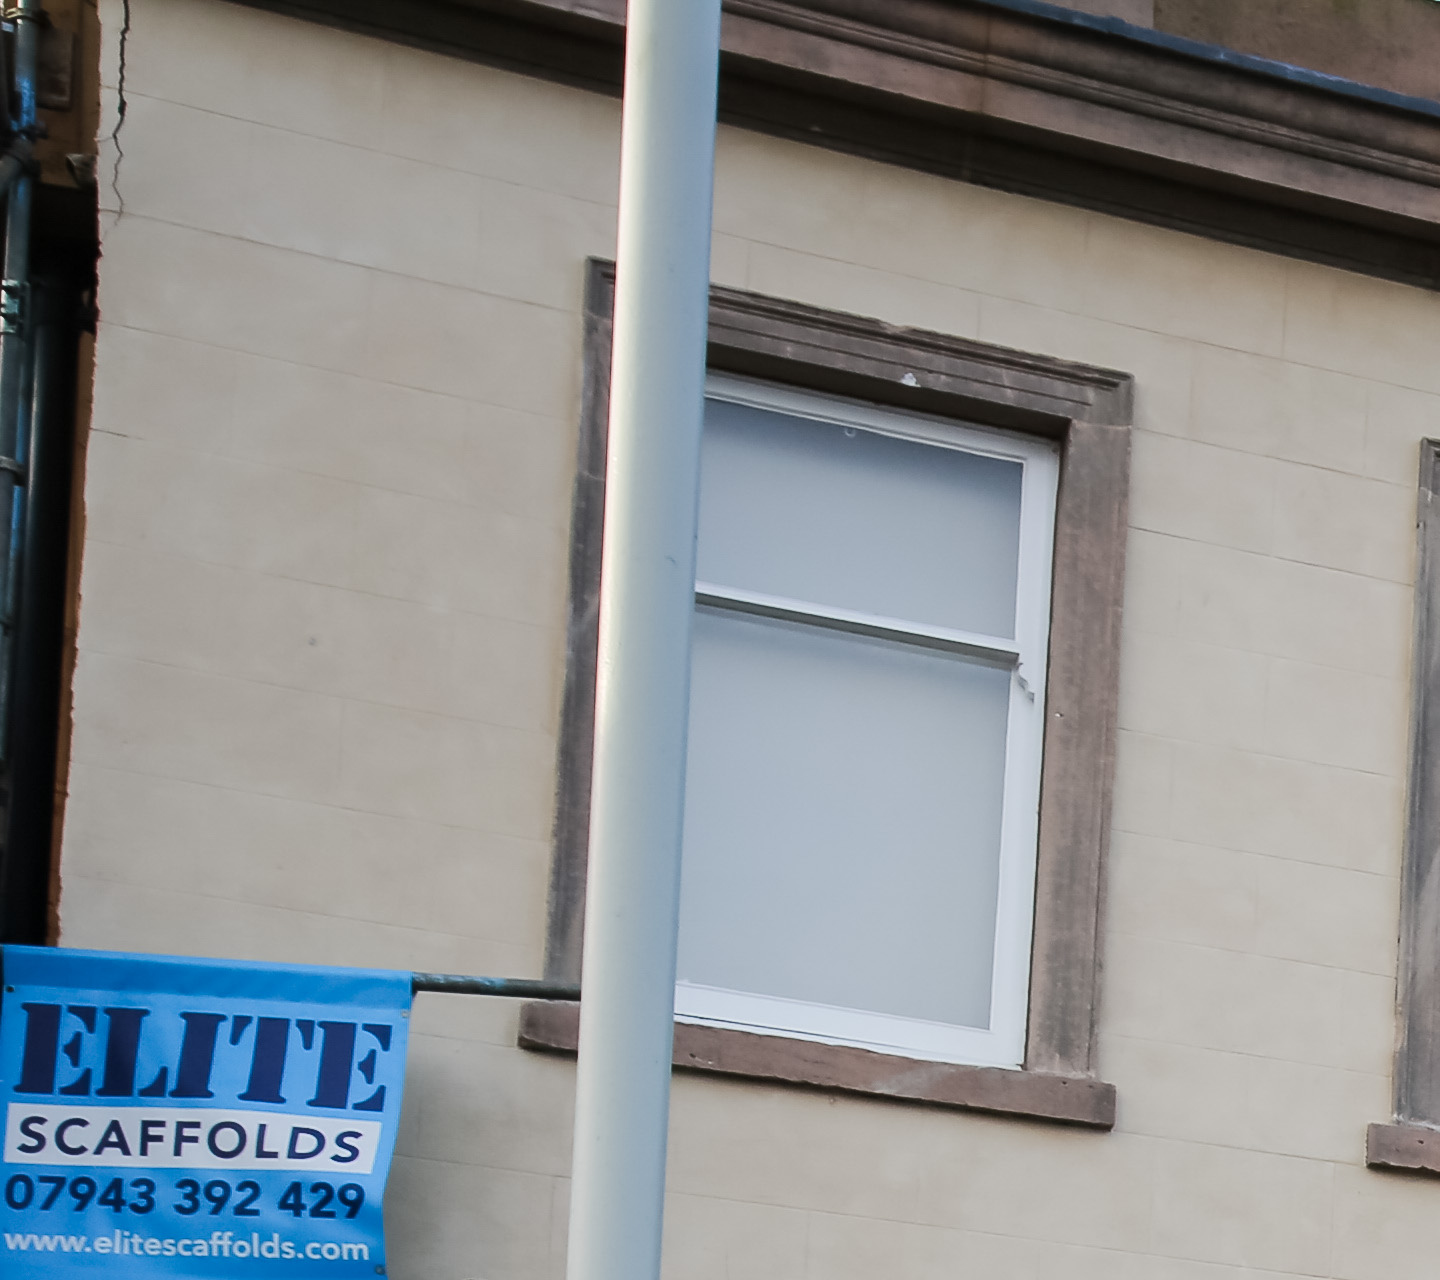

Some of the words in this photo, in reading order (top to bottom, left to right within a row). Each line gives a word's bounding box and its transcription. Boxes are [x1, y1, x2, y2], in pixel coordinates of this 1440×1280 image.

[13, 1002, 392, 1112] ELITE
[17, 1115, 364, 1163] SCAFFOLDS
[5, 1174, 156, 1215] 07943
[173, 1178, 261, 1216] 392
[277, 1182, 366, 1219] 429
[4, 1229, 370, 1261] www.elitescaffolds.com
